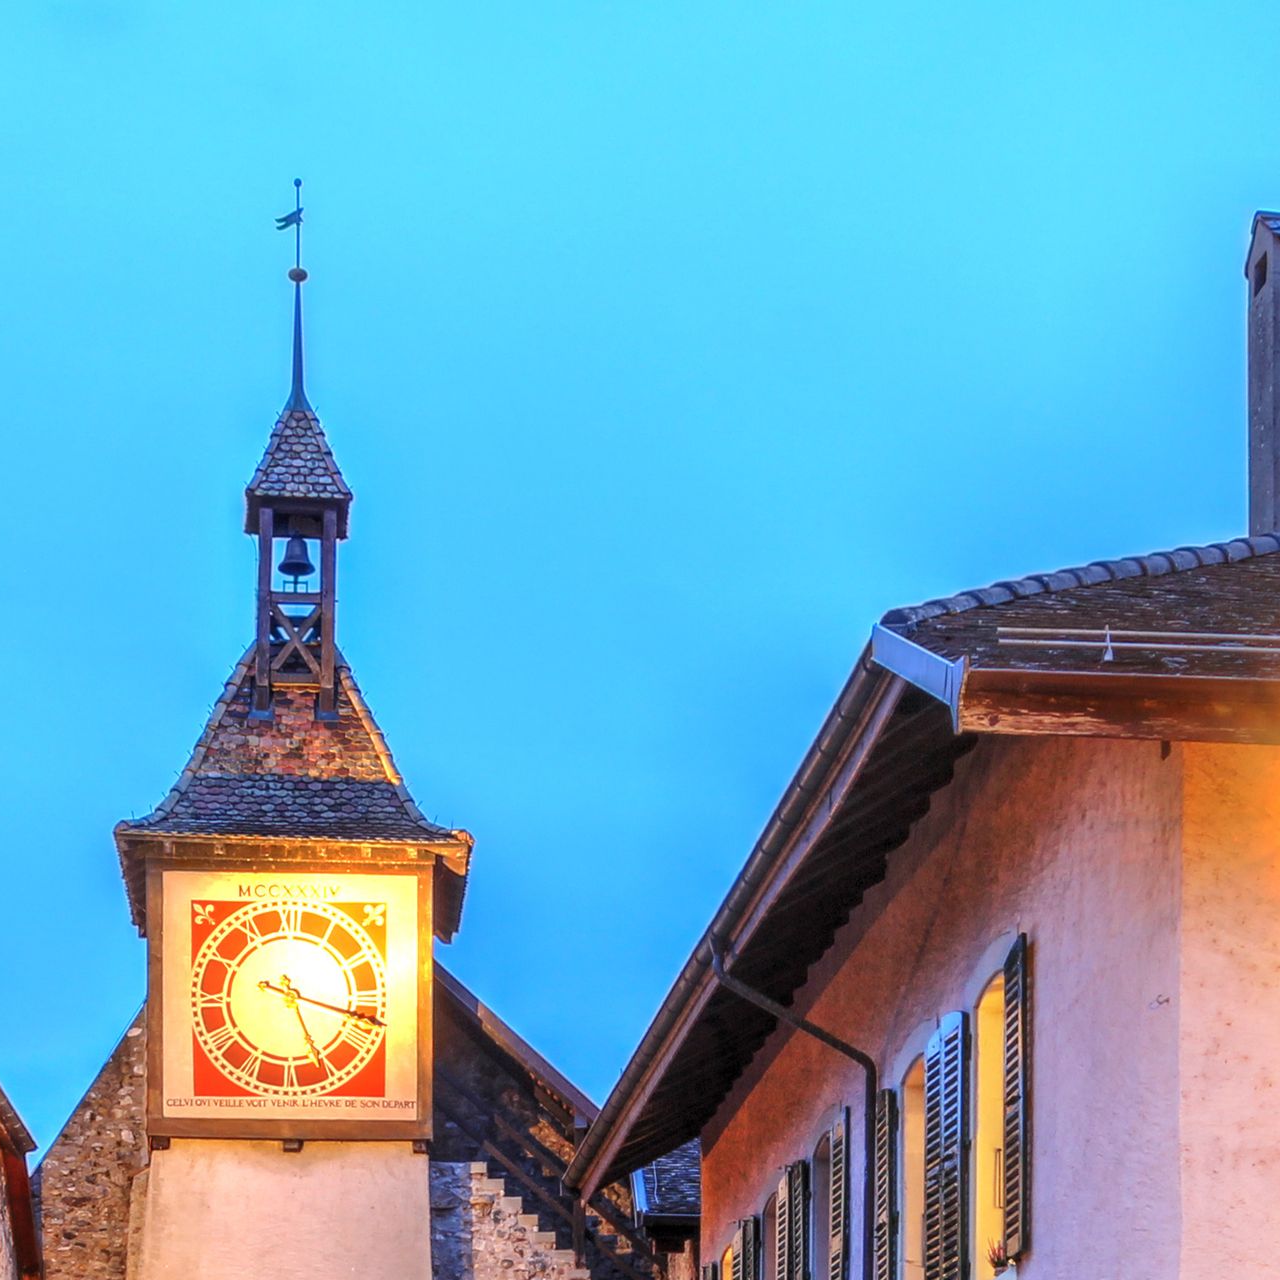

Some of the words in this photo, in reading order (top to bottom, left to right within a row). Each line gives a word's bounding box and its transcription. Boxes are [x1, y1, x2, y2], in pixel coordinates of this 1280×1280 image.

[238, 884, 340, 898] MCCXXXIV
[166, 1098, 193, 1107] CELVI
[214, 1099, 244, 1108] VEILLE
[246, 1099, 267, 1108] VOIT
[271, 1099, 298, 1108] VENIR
[345, 1099, 357, 1108] DE
[360, 1100, 379, 1108] SON
[382, 1100, 416, 1109] DEPART
